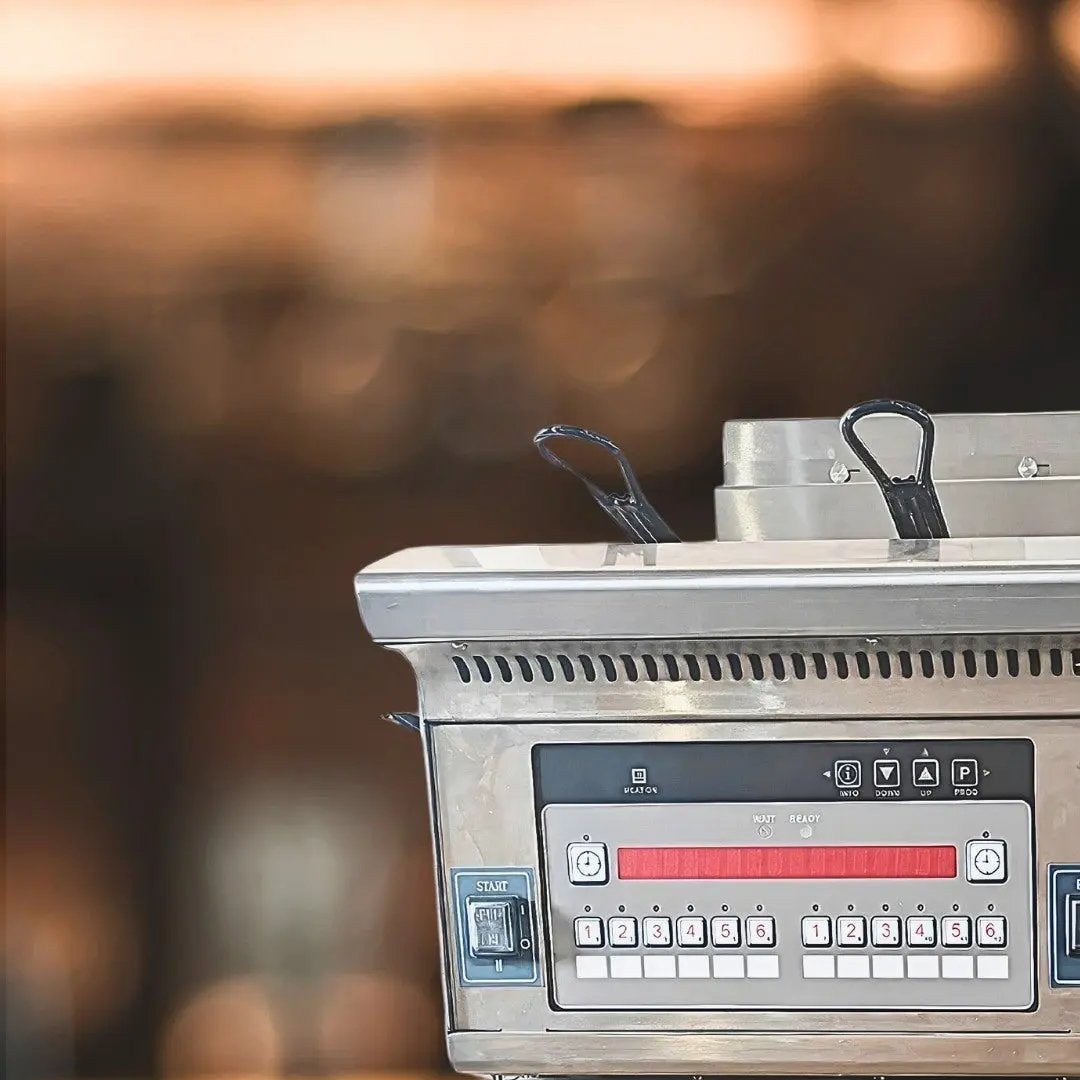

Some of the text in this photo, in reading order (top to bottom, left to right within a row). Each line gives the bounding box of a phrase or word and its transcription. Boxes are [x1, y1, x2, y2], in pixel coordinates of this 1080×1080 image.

[476, 880, 509, 892] START
[584, 925, 592, 939] 1
[618, 925, 628, 939] 2
[652, 924, 662, 939] 3
[686, 924, 696, 938] 4
[720, 924, 730, 938] 5
[756, 923, 766, 938] 6
[812, 923, 995, 938] 1 2 3 4 5 6
